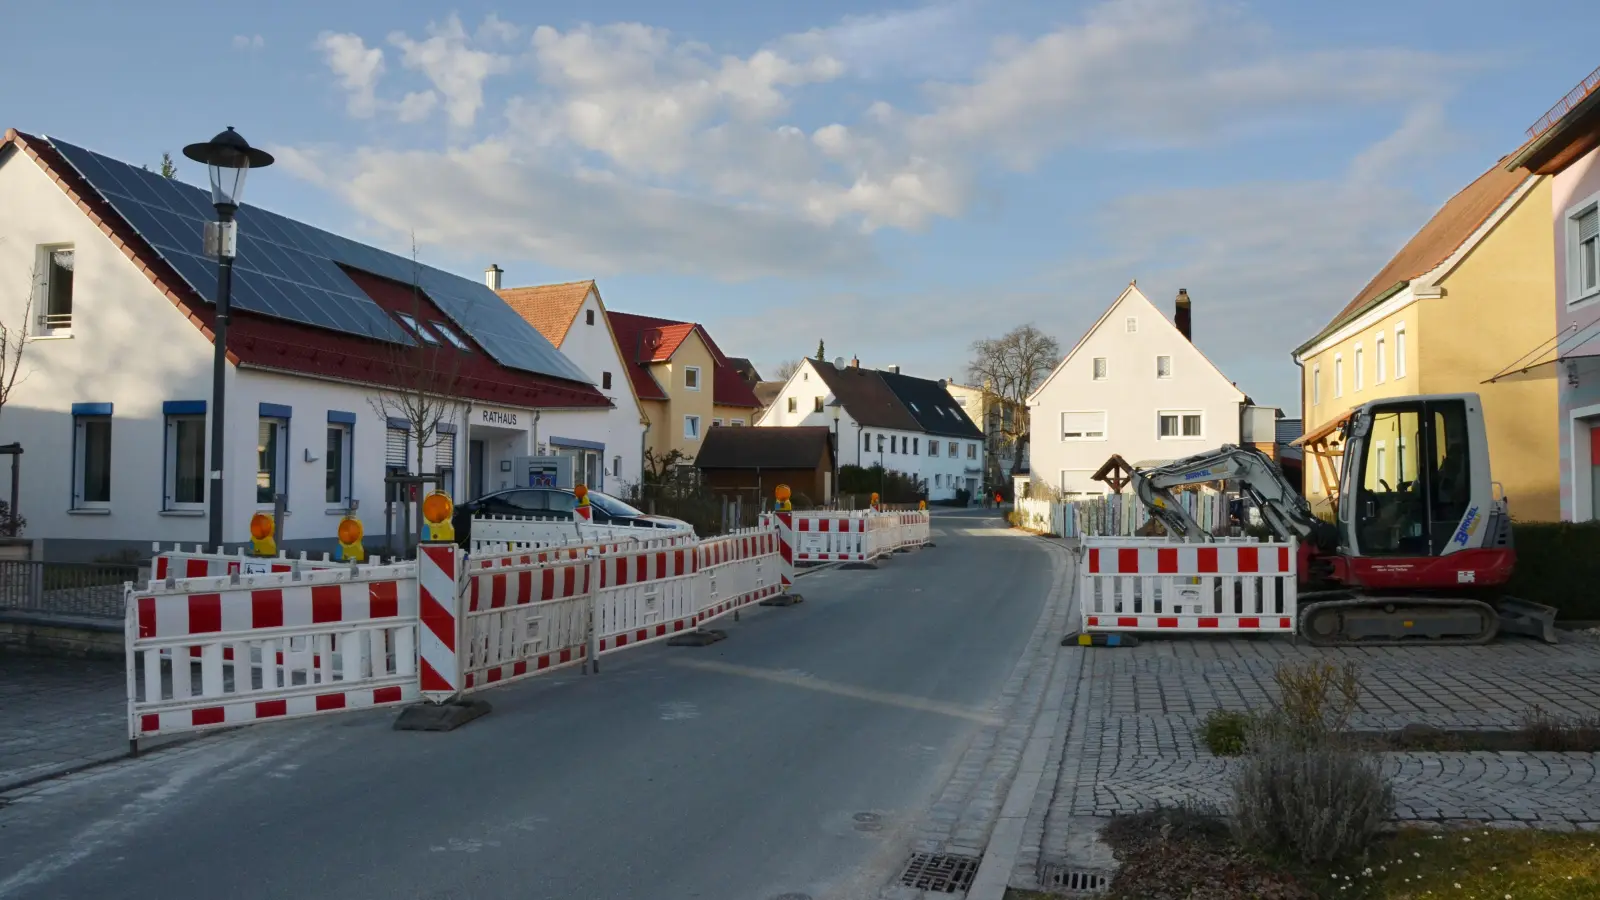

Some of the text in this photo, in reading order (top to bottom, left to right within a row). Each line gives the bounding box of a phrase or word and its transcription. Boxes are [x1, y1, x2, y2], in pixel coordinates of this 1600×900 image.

[482, 410, 517, 425] RATHAUS
[1185, 470, 1211, 480] BIRKEL
[1454, 506, 1479, 546] BIRKEL
